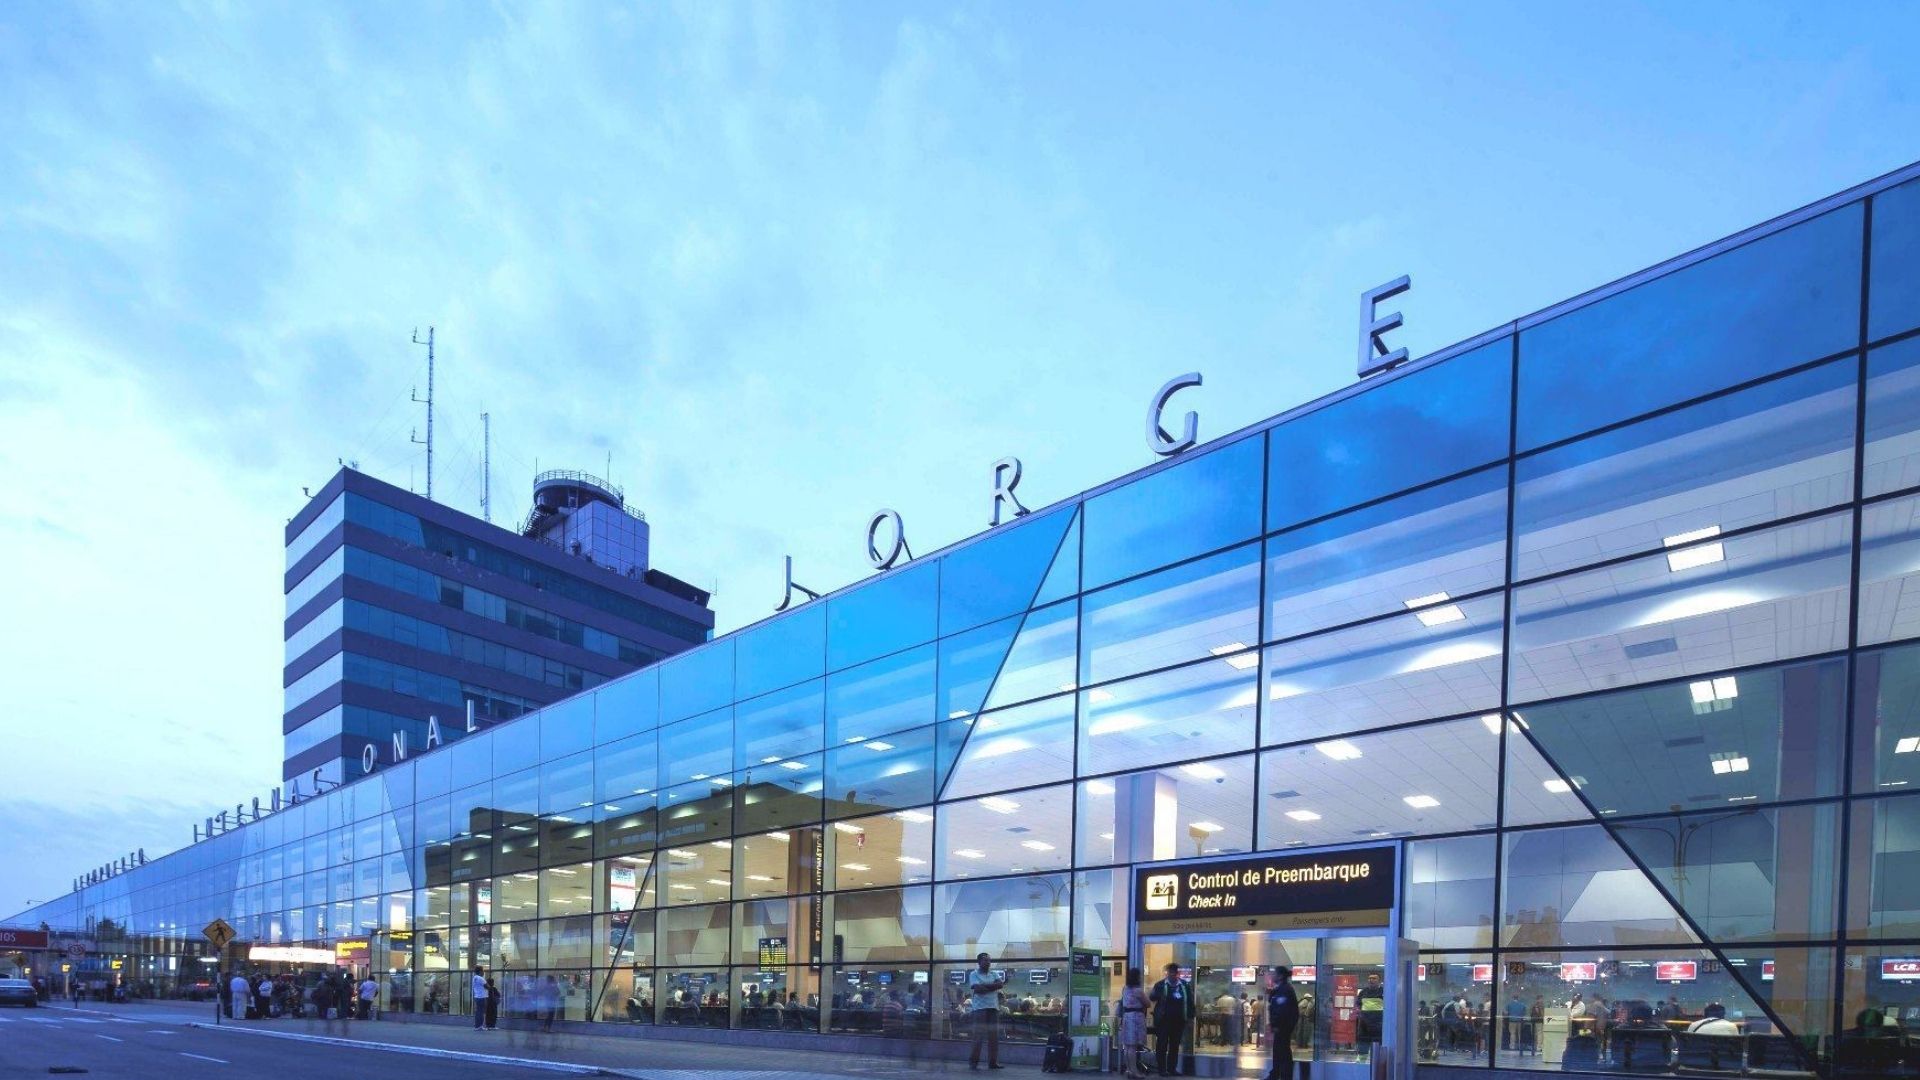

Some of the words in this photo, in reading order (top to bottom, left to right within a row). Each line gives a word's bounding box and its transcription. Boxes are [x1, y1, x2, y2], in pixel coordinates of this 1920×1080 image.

[774, 274, 1411, 613] JORGE
[1188, 873, 1239, 890] Control
[1243, 869, 1261, 886] de
[1265, 861, 1370, 885] Preembarque
[1188, 895, 1221, 909] Check
[1224, 893, 1236, 907] In
[1702, 961, 1720, 973] 30
